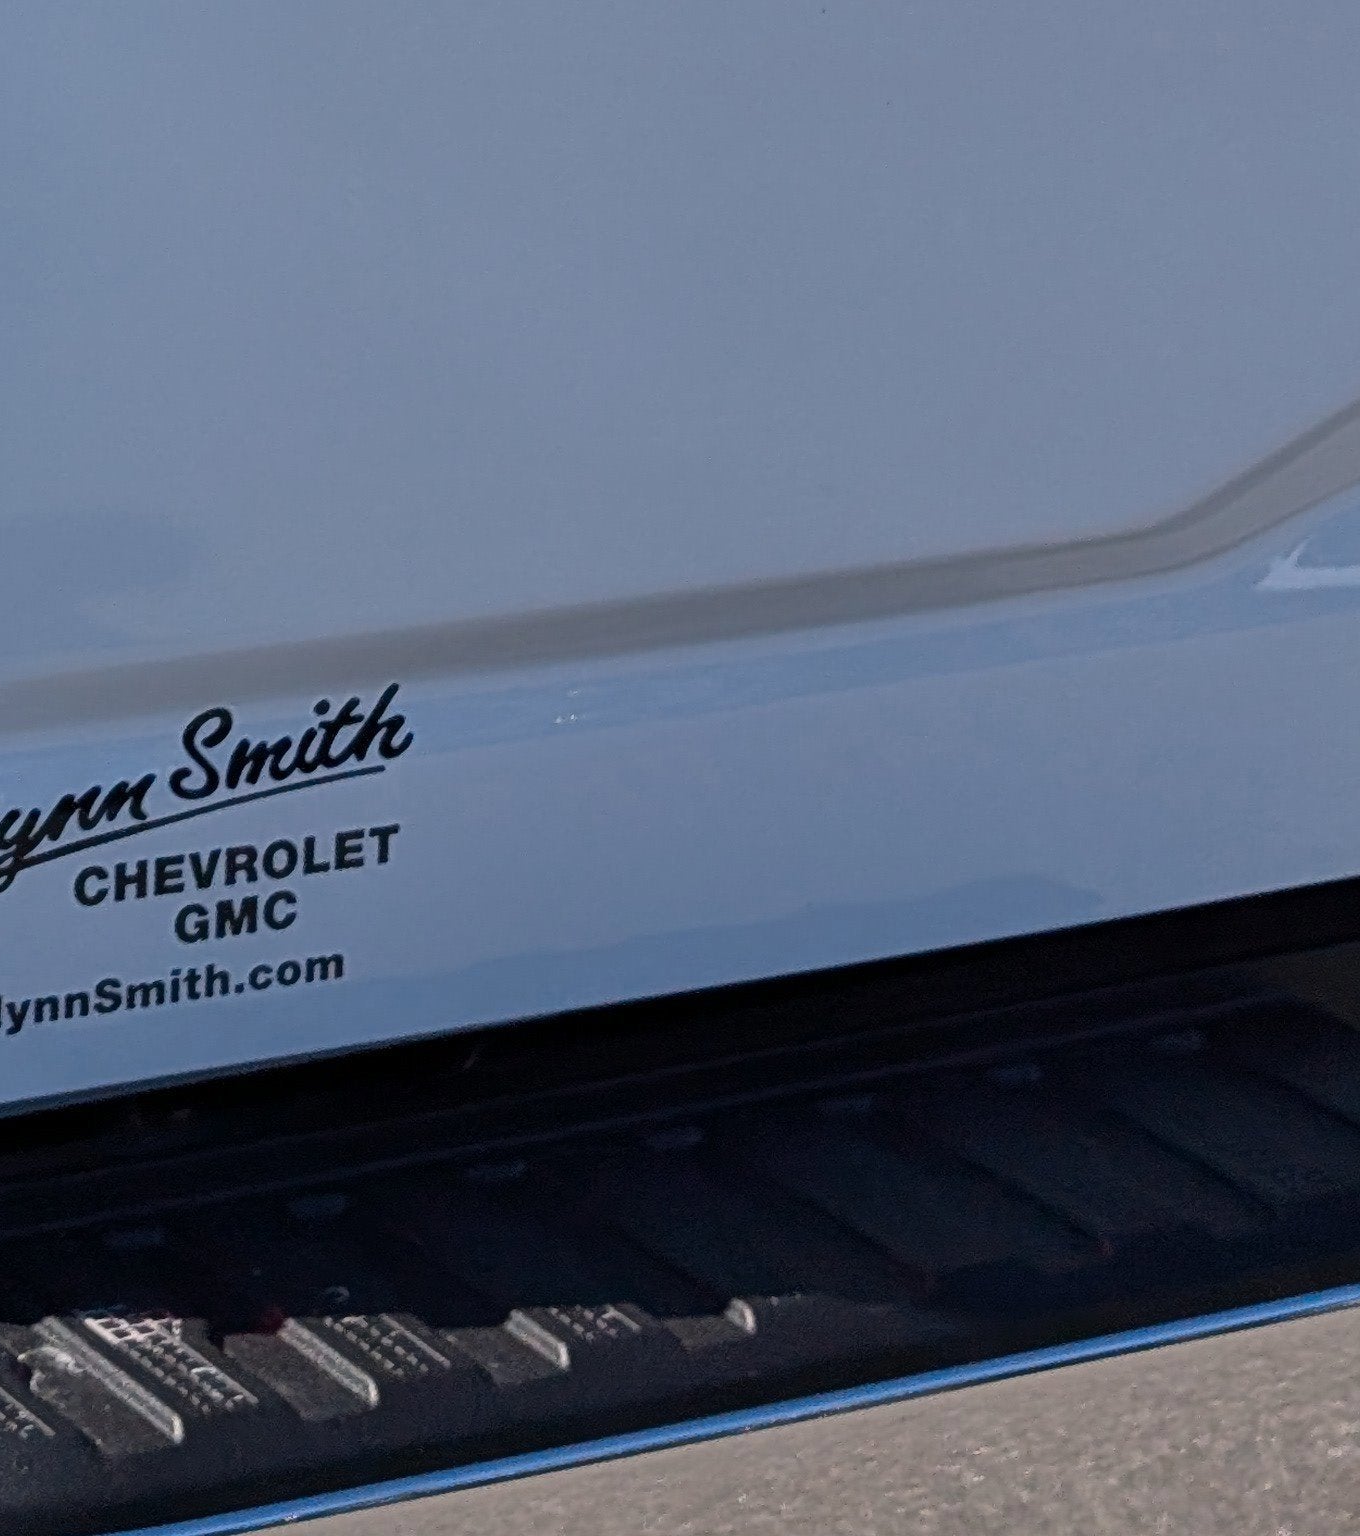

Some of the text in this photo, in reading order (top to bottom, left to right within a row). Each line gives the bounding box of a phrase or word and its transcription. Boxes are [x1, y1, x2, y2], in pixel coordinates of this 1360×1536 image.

[168, 682, 415, 801] Smith
[74, 822, 402, 908] CHEVROLET
[175, 889, 298, 946] GMC
